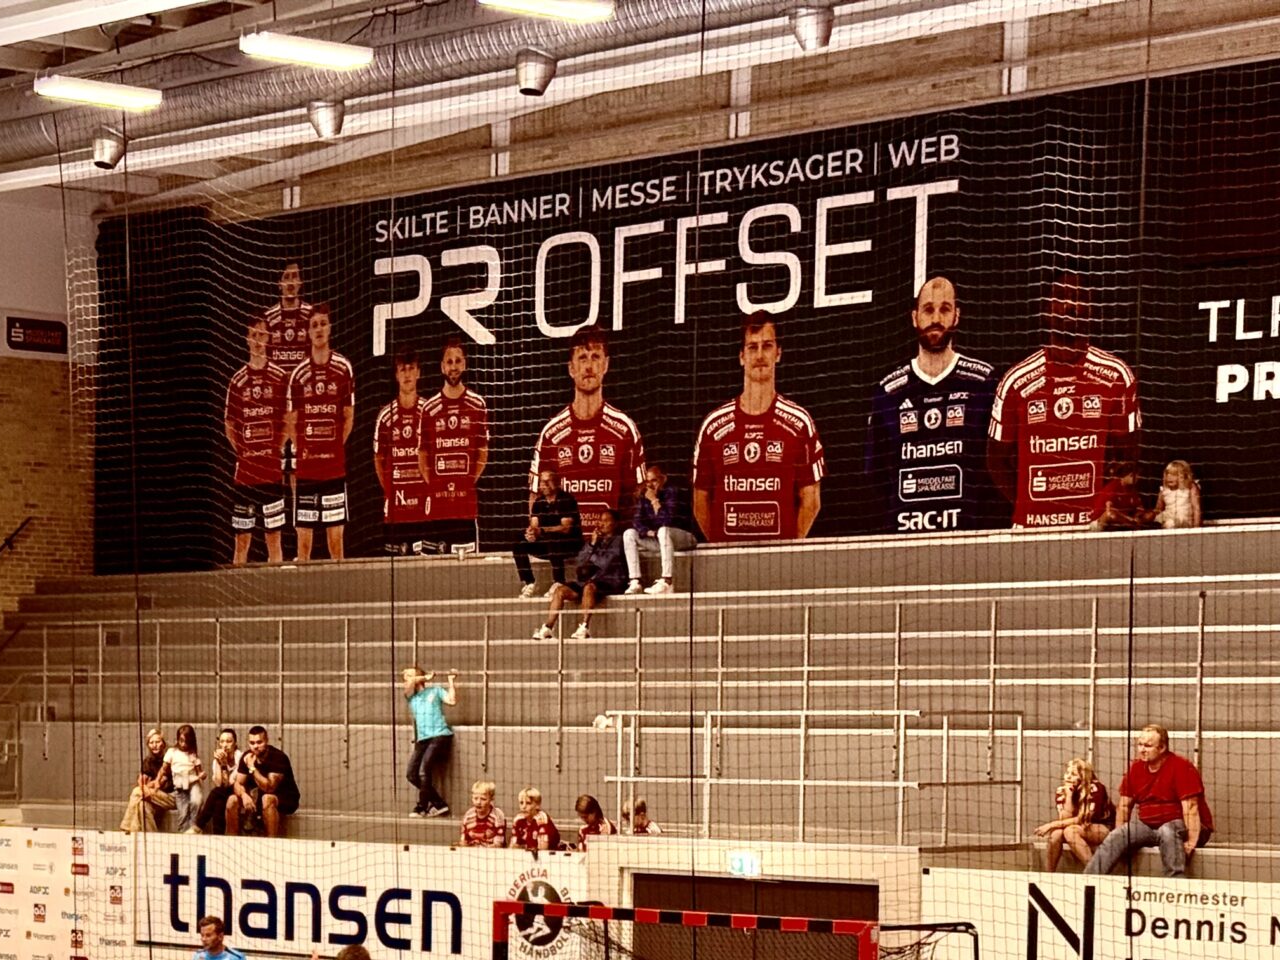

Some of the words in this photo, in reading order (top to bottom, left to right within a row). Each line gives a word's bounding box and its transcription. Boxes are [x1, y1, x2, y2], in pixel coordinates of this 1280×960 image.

[375, 212, 448, 244] SKILTE
[469, 193, 570, 229] BANNER
[592, 176, 677, 210] MESSE
[700, 148, 863, 195] TRYKSAGER
[887, 134, 960, 169] WEB
[901, 440, 963, 460] thansen
[1030, 434, 1098, 454] thansen
[724, 474, 781, 492] thansen
[1026, 513, 1074, 525] HANSEN
[163, 853, 463, 955] thansen
[1124, 908, 1248, 944] Dennis
